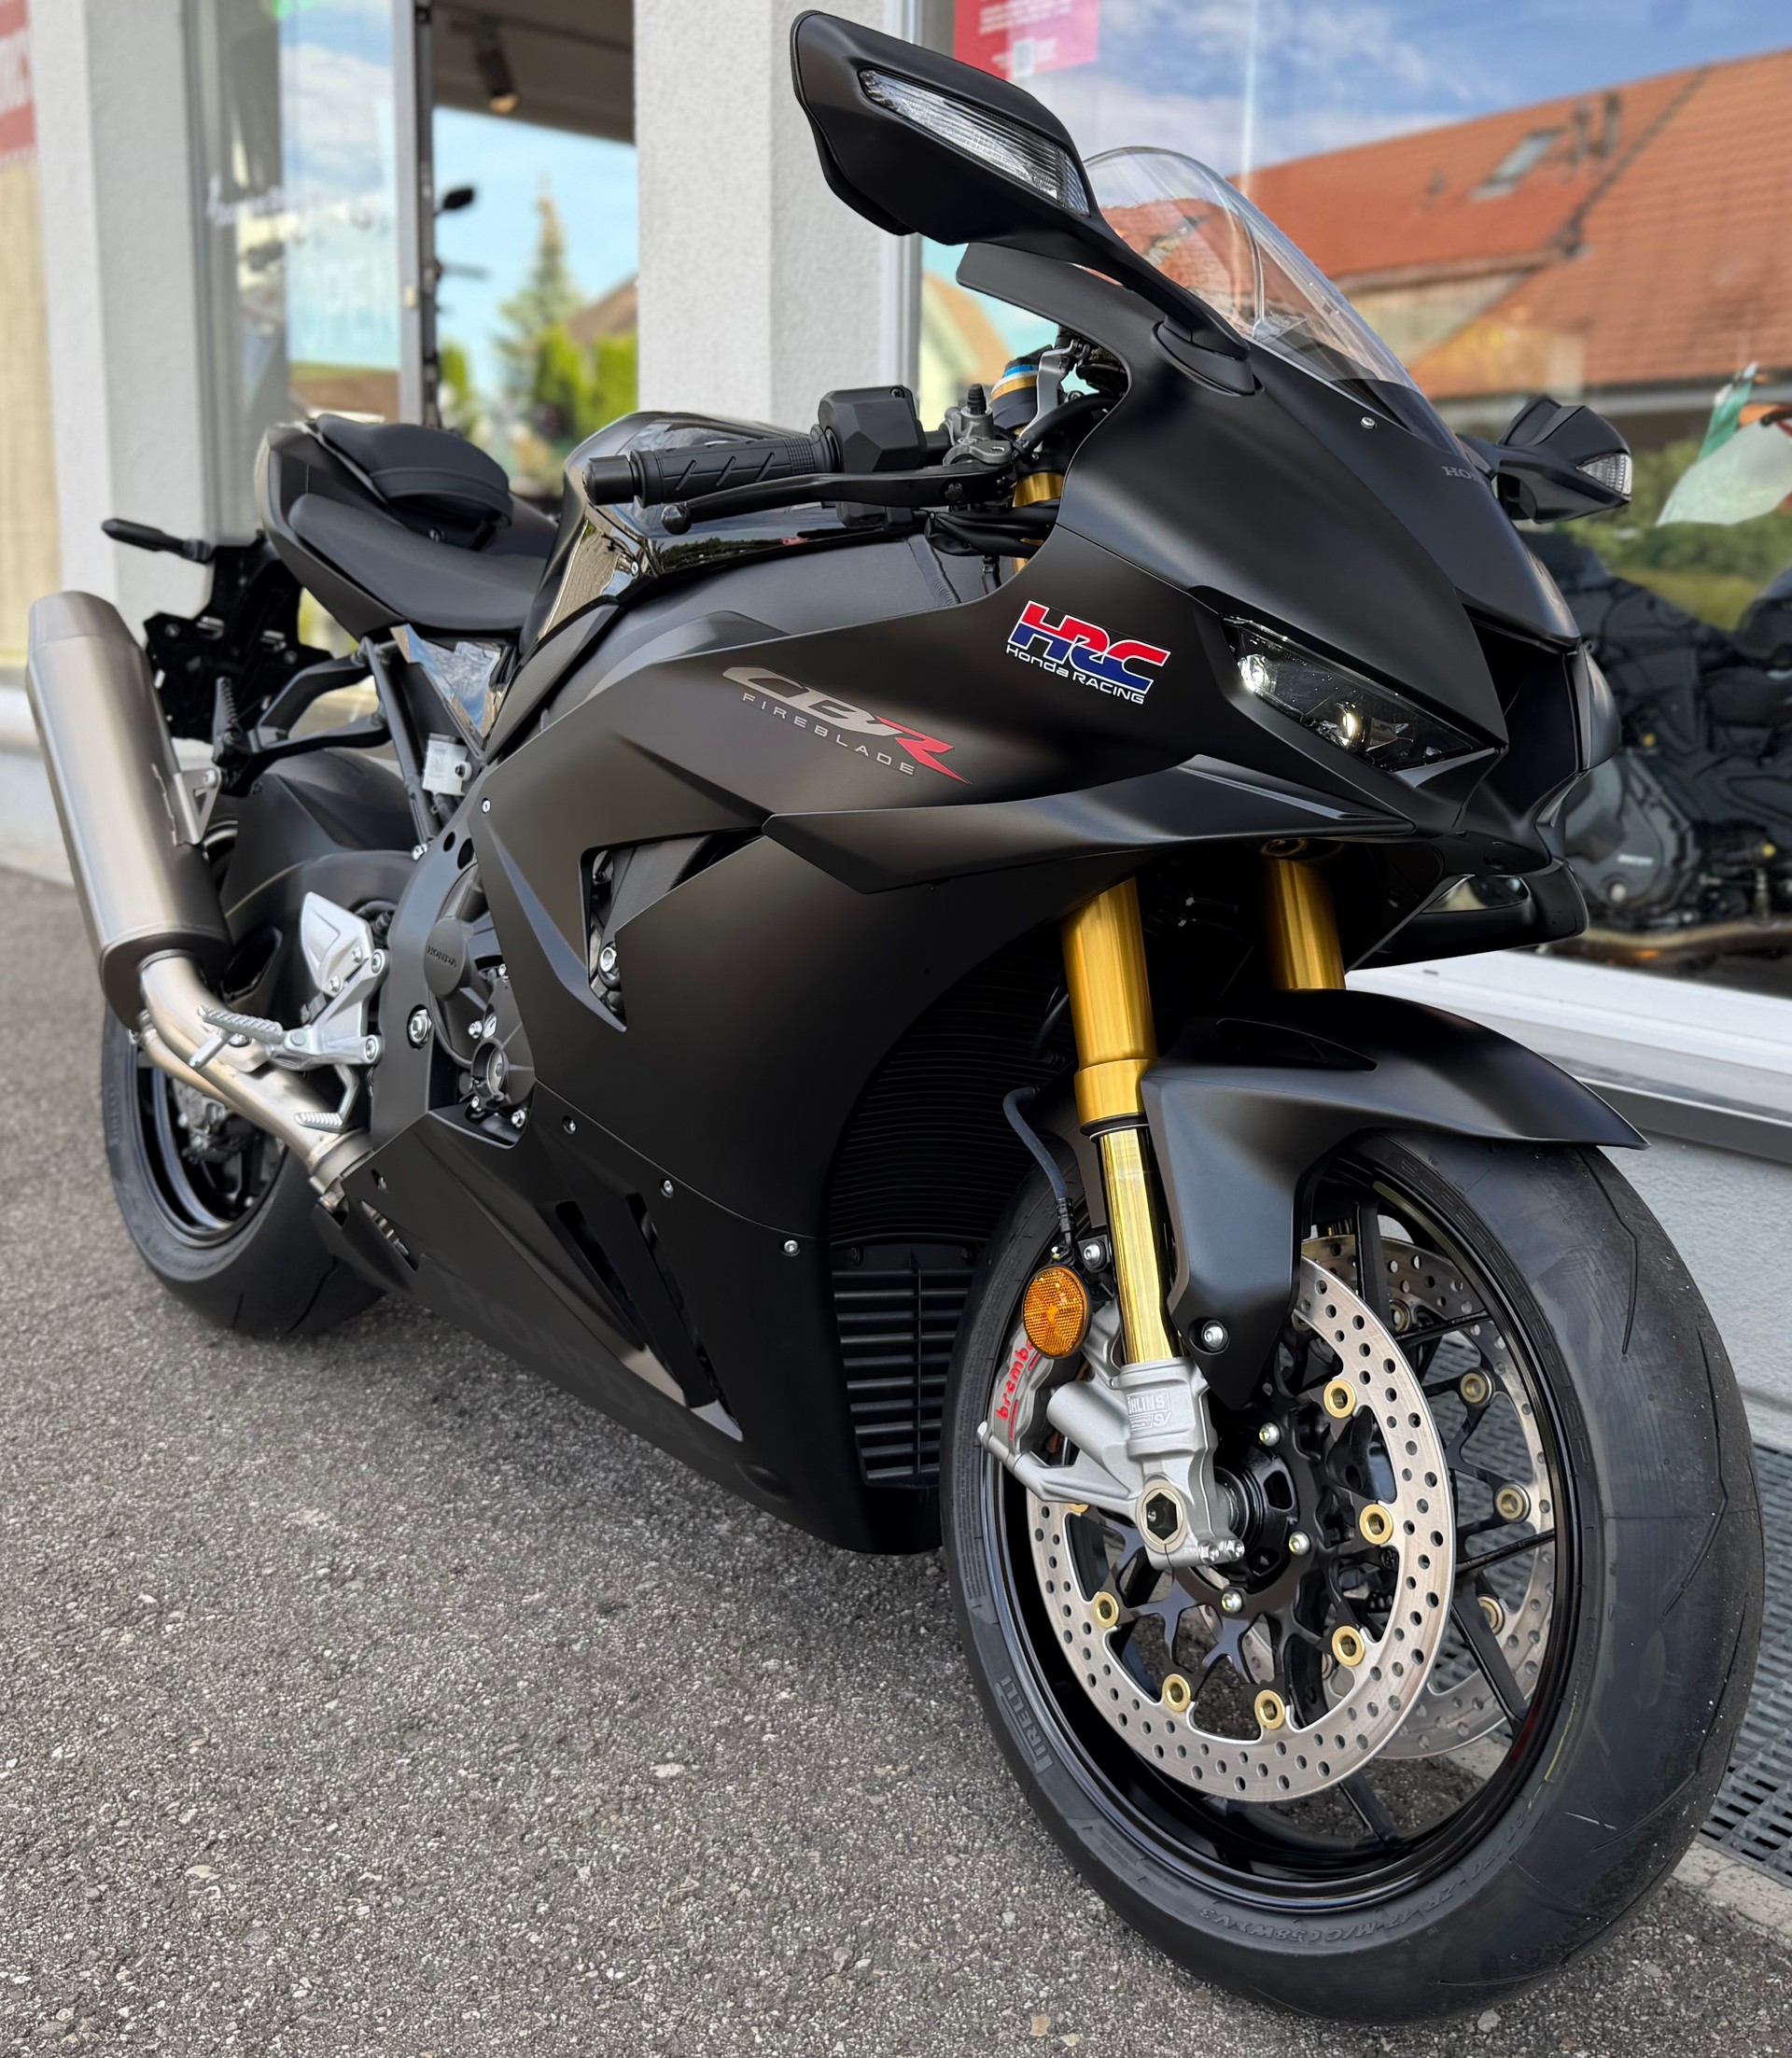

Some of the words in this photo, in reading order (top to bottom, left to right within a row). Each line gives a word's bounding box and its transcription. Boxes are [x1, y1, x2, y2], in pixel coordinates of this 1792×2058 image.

[1005, 644, 1070, 679] Honda
[1072, 670, 1146, 706] RACING
[1007, 599, 1172, 695] HRC
[721, 665, 973, 785] CBR
[742, 692, 916, 777] FIREBLADE
[427, 944, 457, 969] HONDA
[994, 1674, 1055, 1775] PIRELLI
